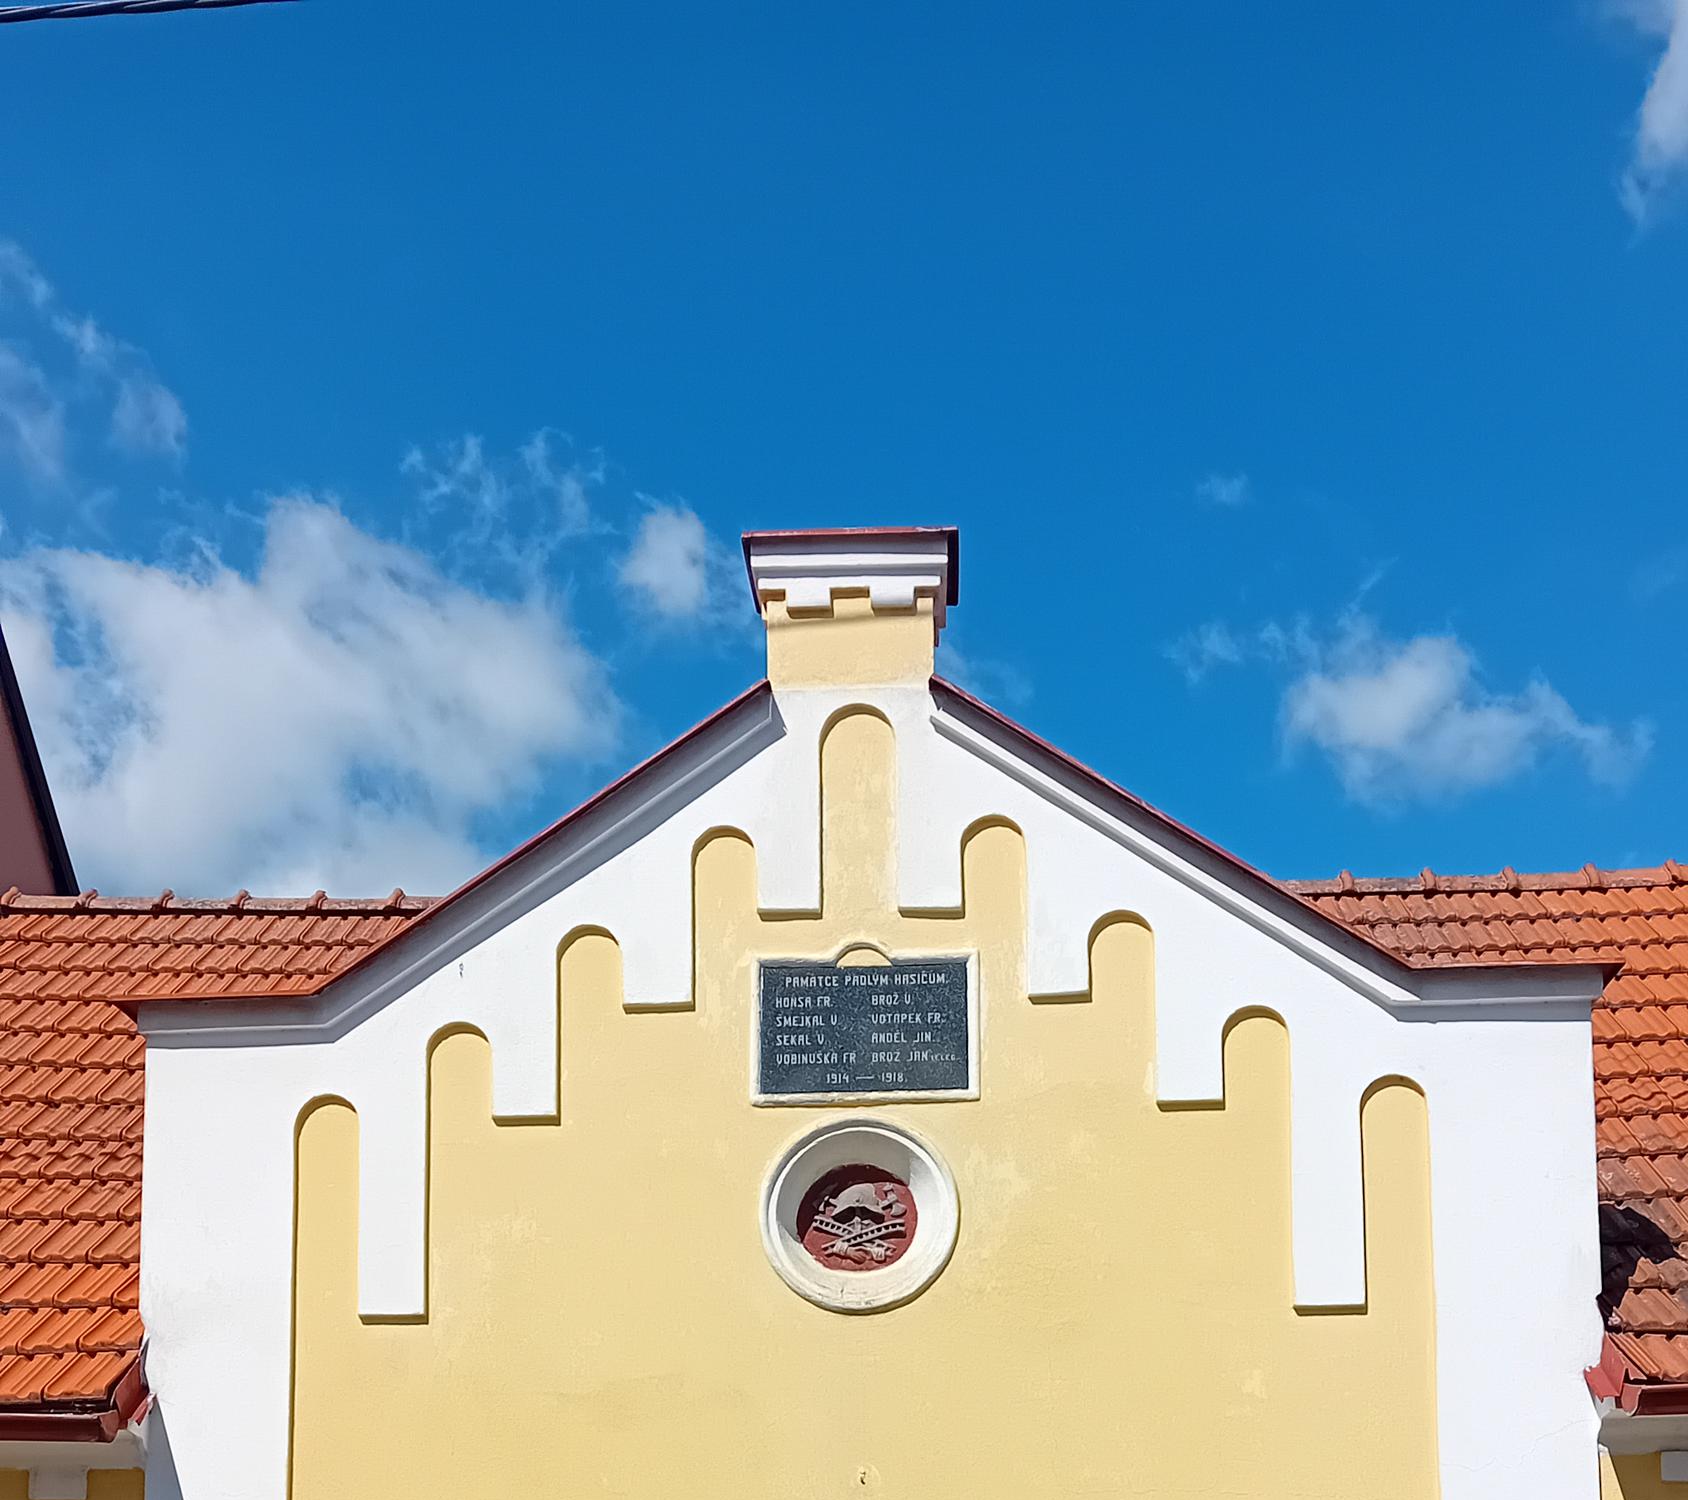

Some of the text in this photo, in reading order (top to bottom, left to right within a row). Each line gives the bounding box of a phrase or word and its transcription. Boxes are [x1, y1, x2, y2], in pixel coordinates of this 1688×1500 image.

[775, 996, 812, 1009] HONSA
[871, 992, 899, 1006] BROŽ
[775, 1034, 812, 1046] SEKAL
[826, 1073, 850, 1084] 1914
